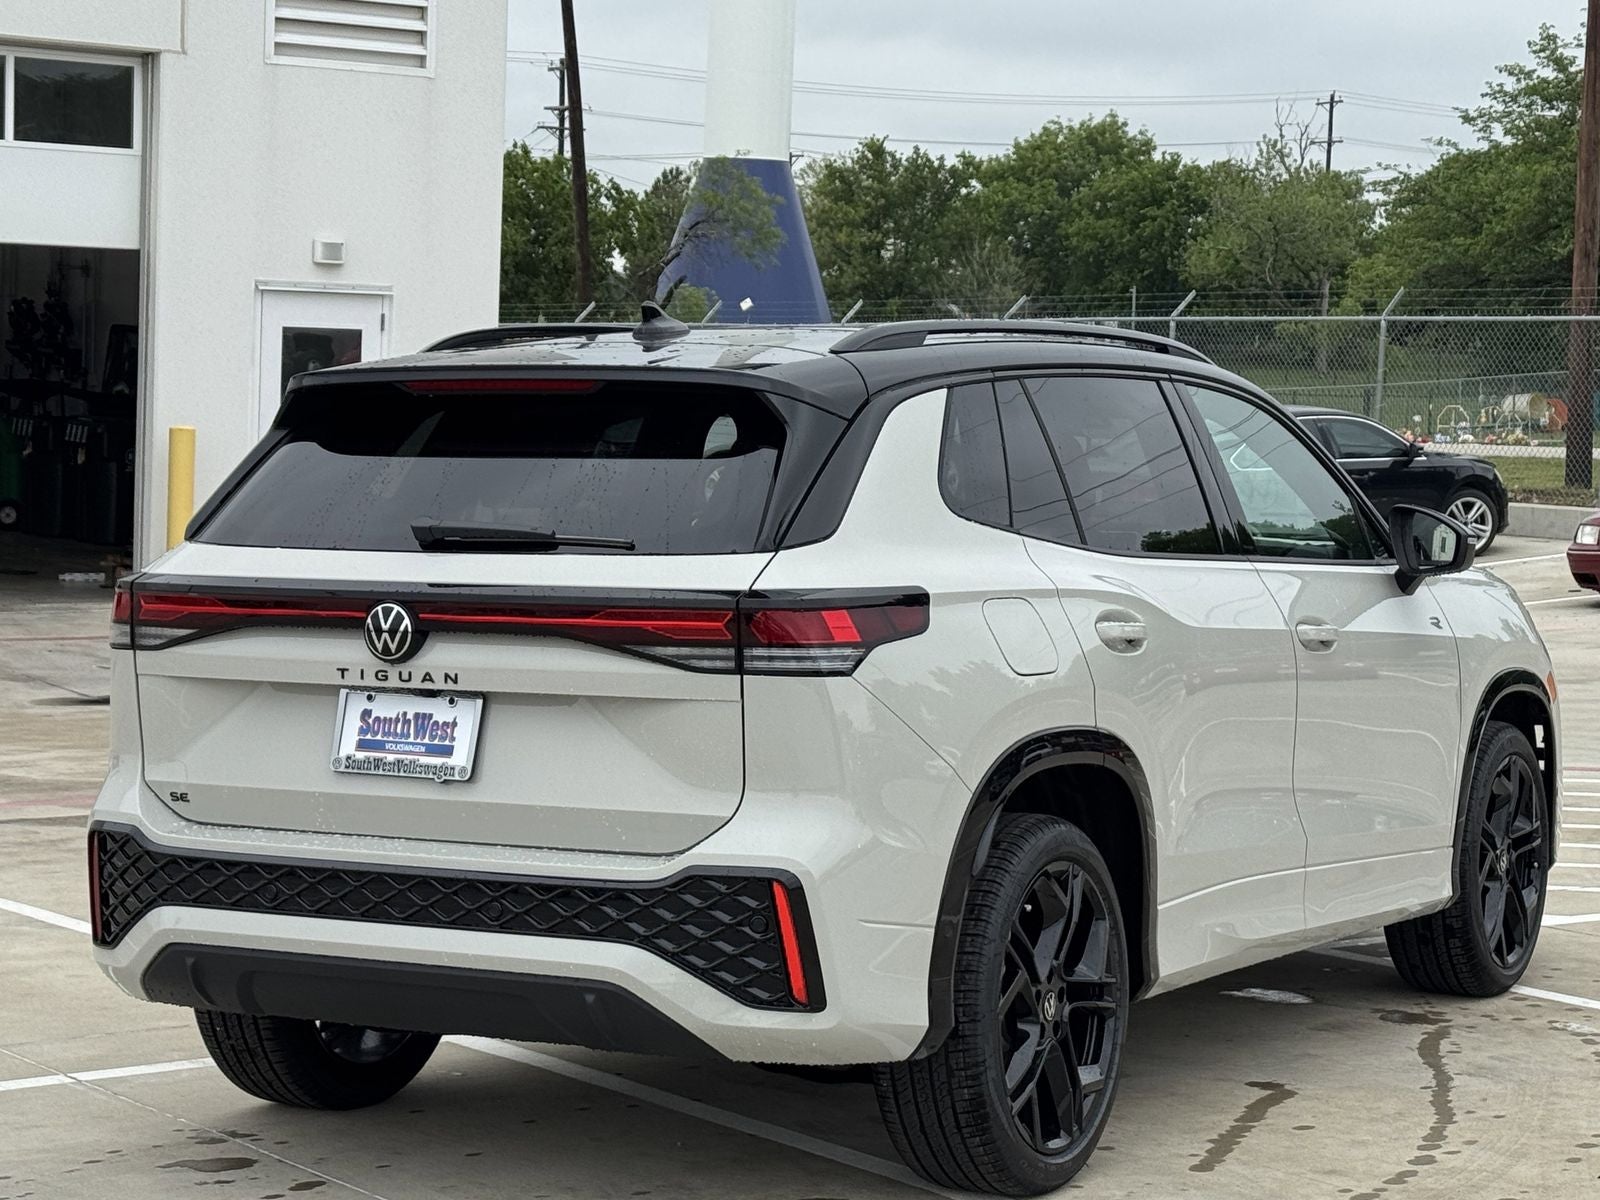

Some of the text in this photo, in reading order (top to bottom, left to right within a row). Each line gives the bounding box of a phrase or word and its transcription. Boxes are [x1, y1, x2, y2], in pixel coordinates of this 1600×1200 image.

[336, 667, 460, 685] TIGUAN
[384, 742, 426, 753] VOLKSWAGEN
[169, 791, 191, 804] SE
